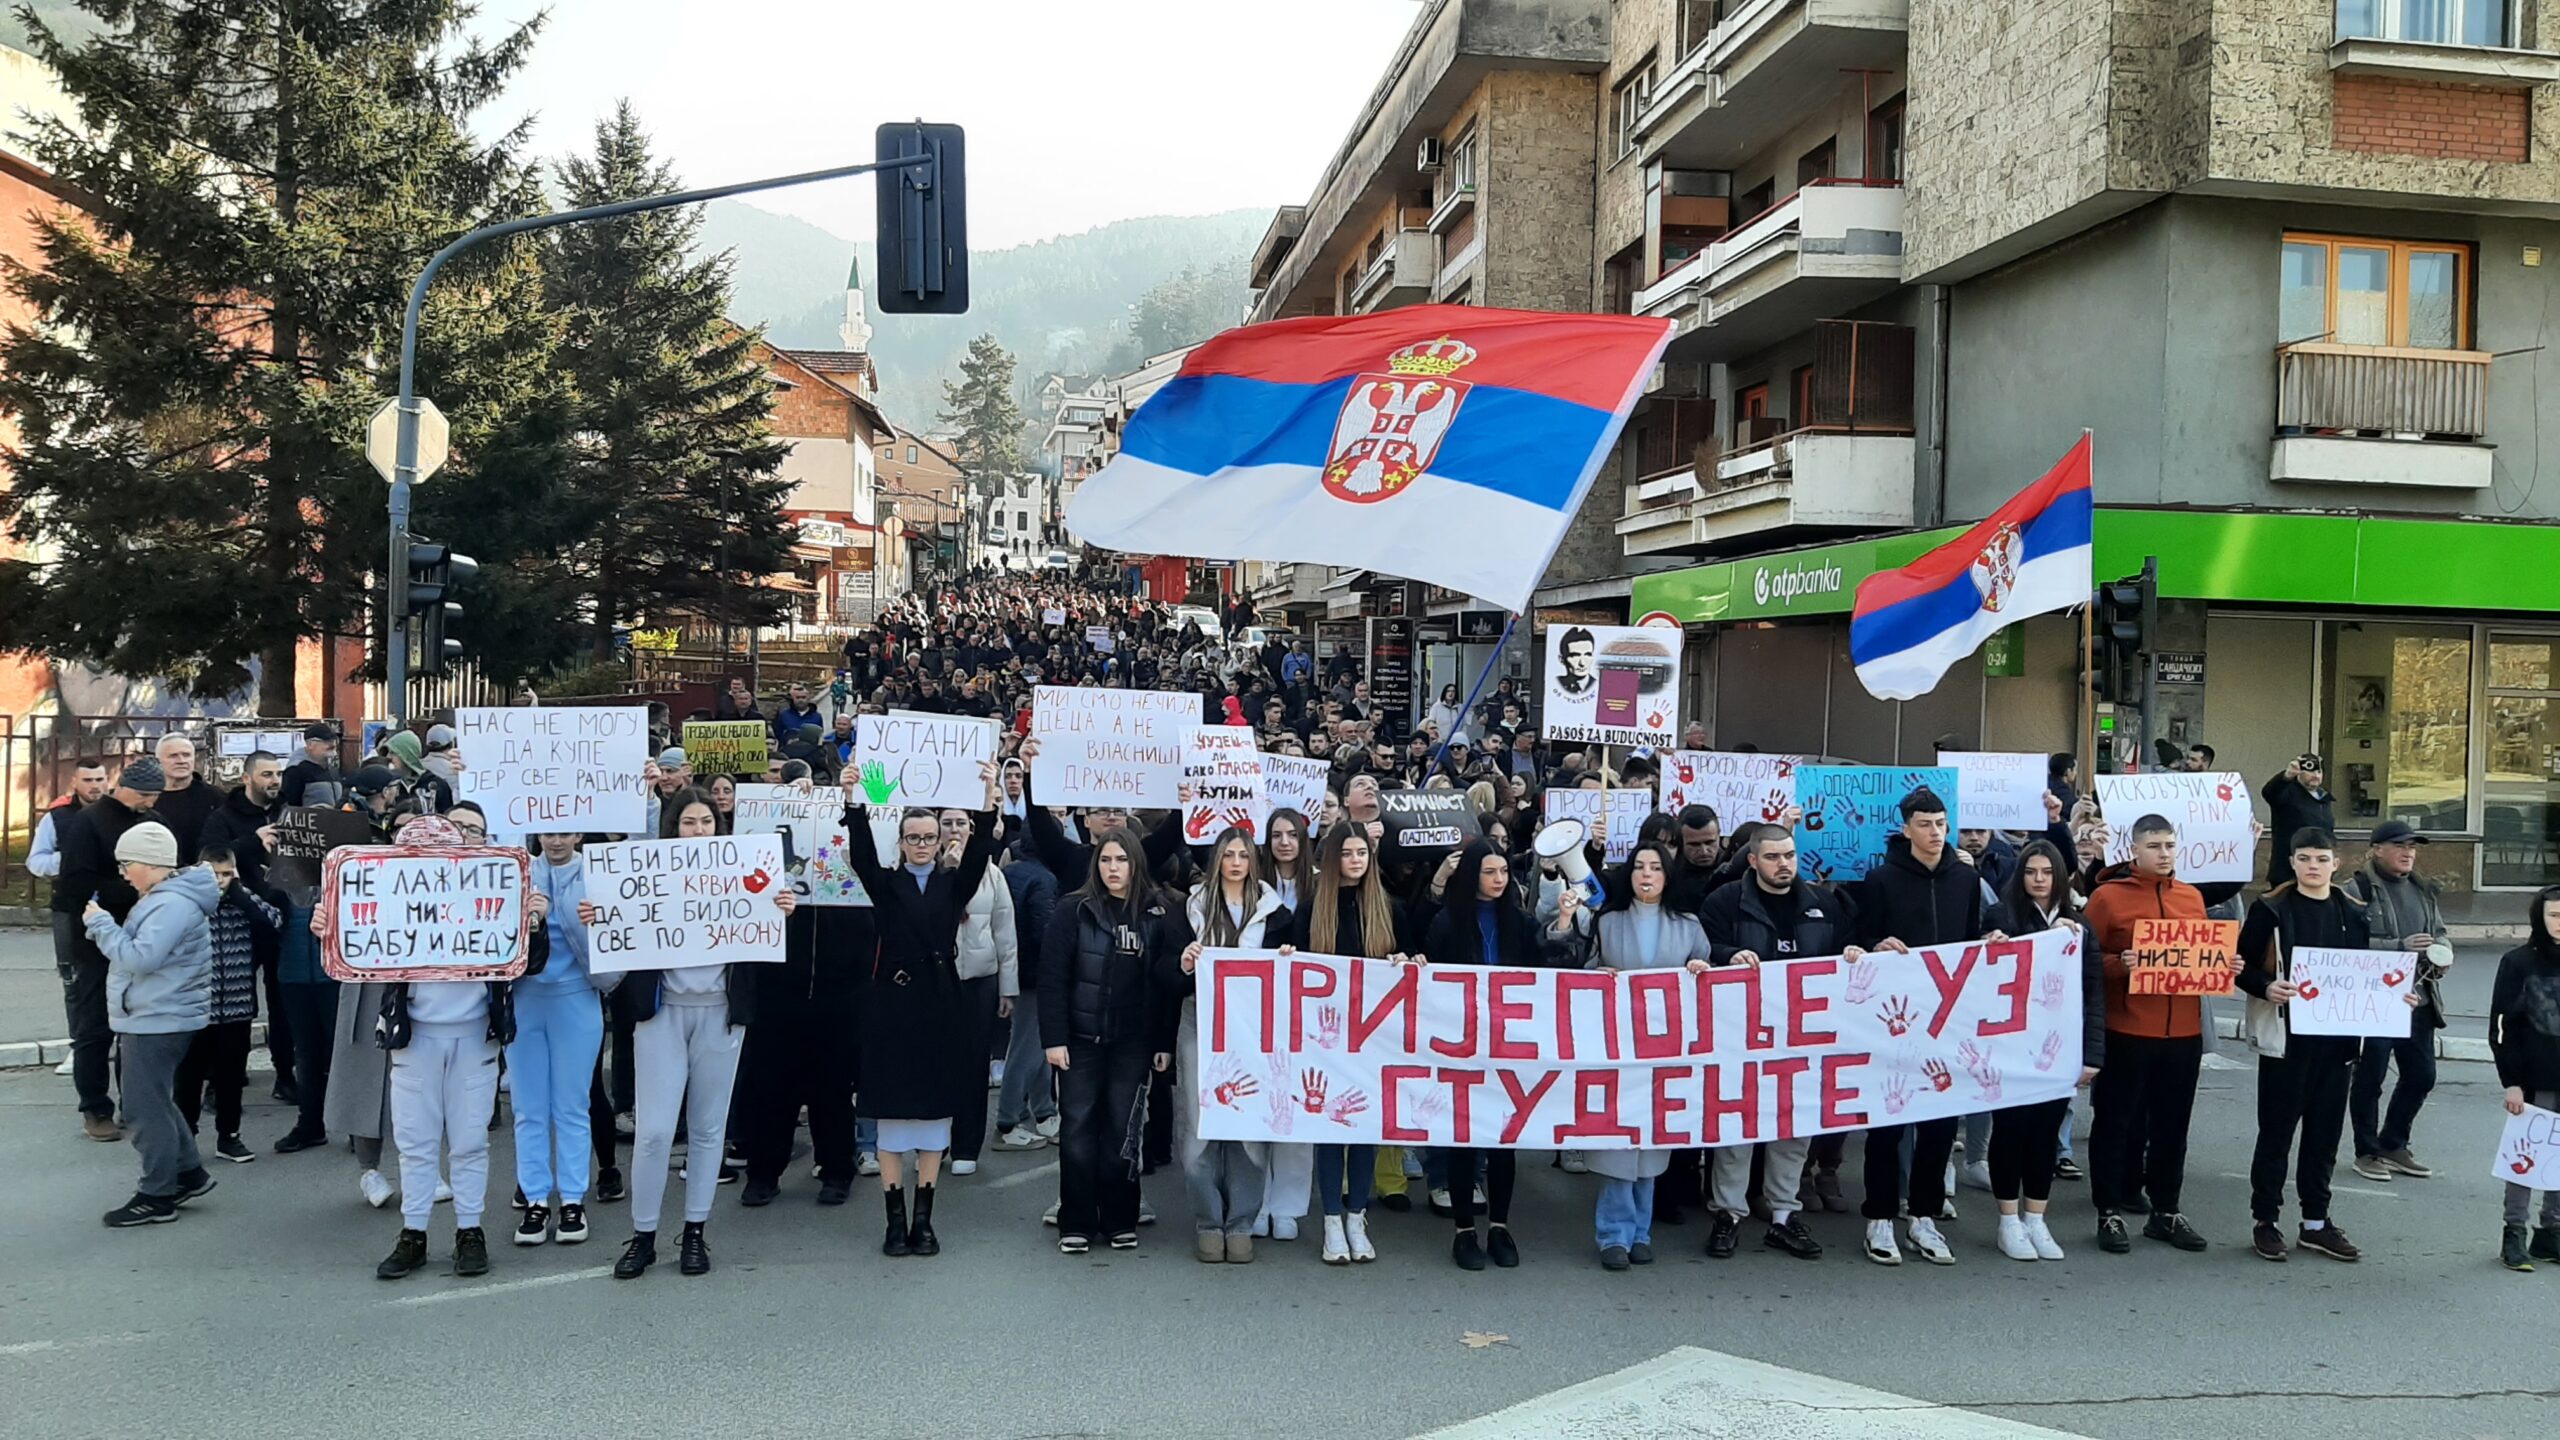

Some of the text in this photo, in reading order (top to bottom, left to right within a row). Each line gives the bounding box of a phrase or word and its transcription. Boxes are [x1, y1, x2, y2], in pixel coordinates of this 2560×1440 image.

[1772, 557, 1842, 606] otpbanka
[1036, 689, 1197, 715] МИ СМО НЕЧИЈА
[463, 711, 638, 737] НАС НЕ МОГУ
[1038, 708, 1154, 738] ДЕЦА А НЕ
[1549, 723, 1673, 747] PASOŠ ZA BUDUĆNOST
[868, 719, 979, 758] УСТАНИ
[499, 739, 607, 766] ДА КУПЕ
[1087, 740, 1181, 765] ВЛАСНИШТ
[1211, 752, 1227, 762] ЛИ
[466, 768, 648, 796] ЈЕР СВЕ РАДИМО
[899, 758, 943, 798] (5)
[1063, 765, 1146, 796] ДРЖАВЕ
[1185, 761, 1262, 777] КАКО ГЛАСНО
[1199, 783, 1254, 800] ЋУТИМ
[1823, 772, 1893, 799] ОДРАСЛИ
[2101, 776, 2210, 802] ИСКЉУЧИ
[508, 794, 593, 826] СРЦЕМ
[1548, 790, 1650, 814] ПРОСВЕТА
[1870, 804, 1902, 827] НИС
[2188, 801, 2232, 824] PINK
[1819, 830, 1861, 852] ДЕЦИ
[589, 846, 620, 874] НЕ
[630, 846, 660, 872] БИ
[342, 862, 515, 897] НЕ ЛАЖИТЕ
[620, 873, 739, 900] ОВЕ КРВИ
[351, 901, 378, 926] !!!
[475, 898, 505, 921] !!!
[591, 898, 752, 926] ДА ЈЕ БИЛО
[344, 927, 519, 958] БАБУ И ДЕДУ
[597, 920, 783, 953] СВЕ ПО ЗАКОНУ
[2138, 920, 2228, 946] ЗНАЊЕ
[2137, 947, 2228, 968] НИЈЕ НА
[2307, 951, 2381, 970] БЛОКАДА
[2137, 970, 2233, 993] ПРОДАЈУ
[2364, 976, 2382, 991] НЕ
[1212, 939, 2034, 1060] ПРИЈЕПОЉЕ УЗ
[2312, 991, 2394, 1023] САДА?
[1382, 1052, 1871, 1146] СТУДЕНТЕ
